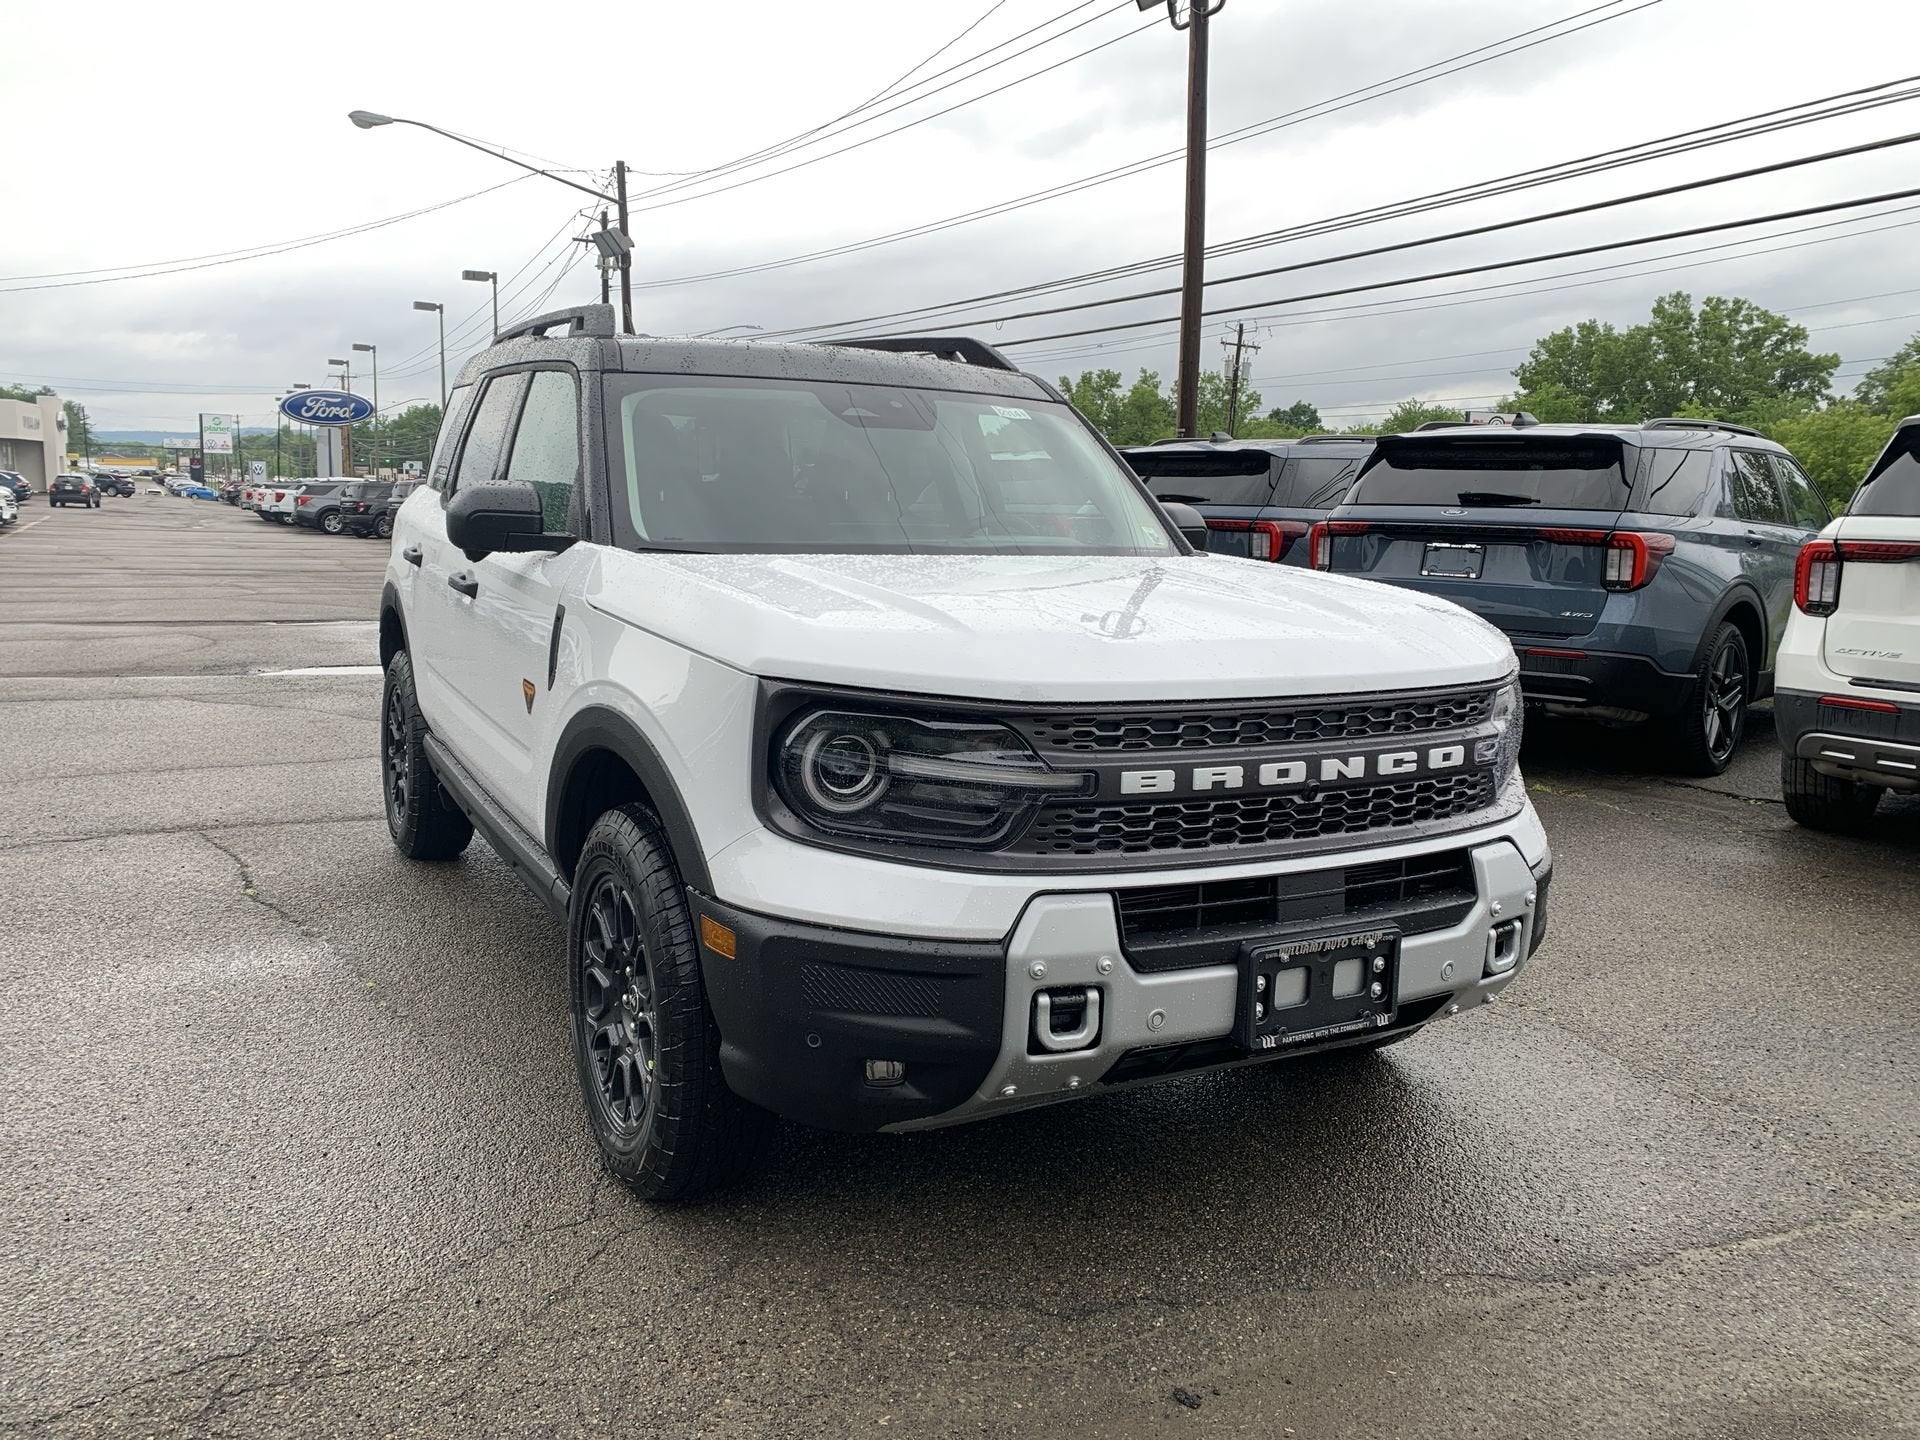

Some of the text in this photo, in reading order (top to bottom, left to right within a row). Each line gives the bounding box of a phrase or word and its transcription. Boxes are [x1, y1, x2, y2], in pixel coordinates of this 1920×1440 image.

[301, 396, 355, 418] Ford
[203, 425, 231, 433] planet
[1834, 647, 1904, 659] ACTIVE
[1119, 745, 1465, 795] BRONCO
[1323, 939, 1349, 951] AUTO
[1282, 1021, 1370, 1043] PARTNERING WITH THE COMMUNITY
